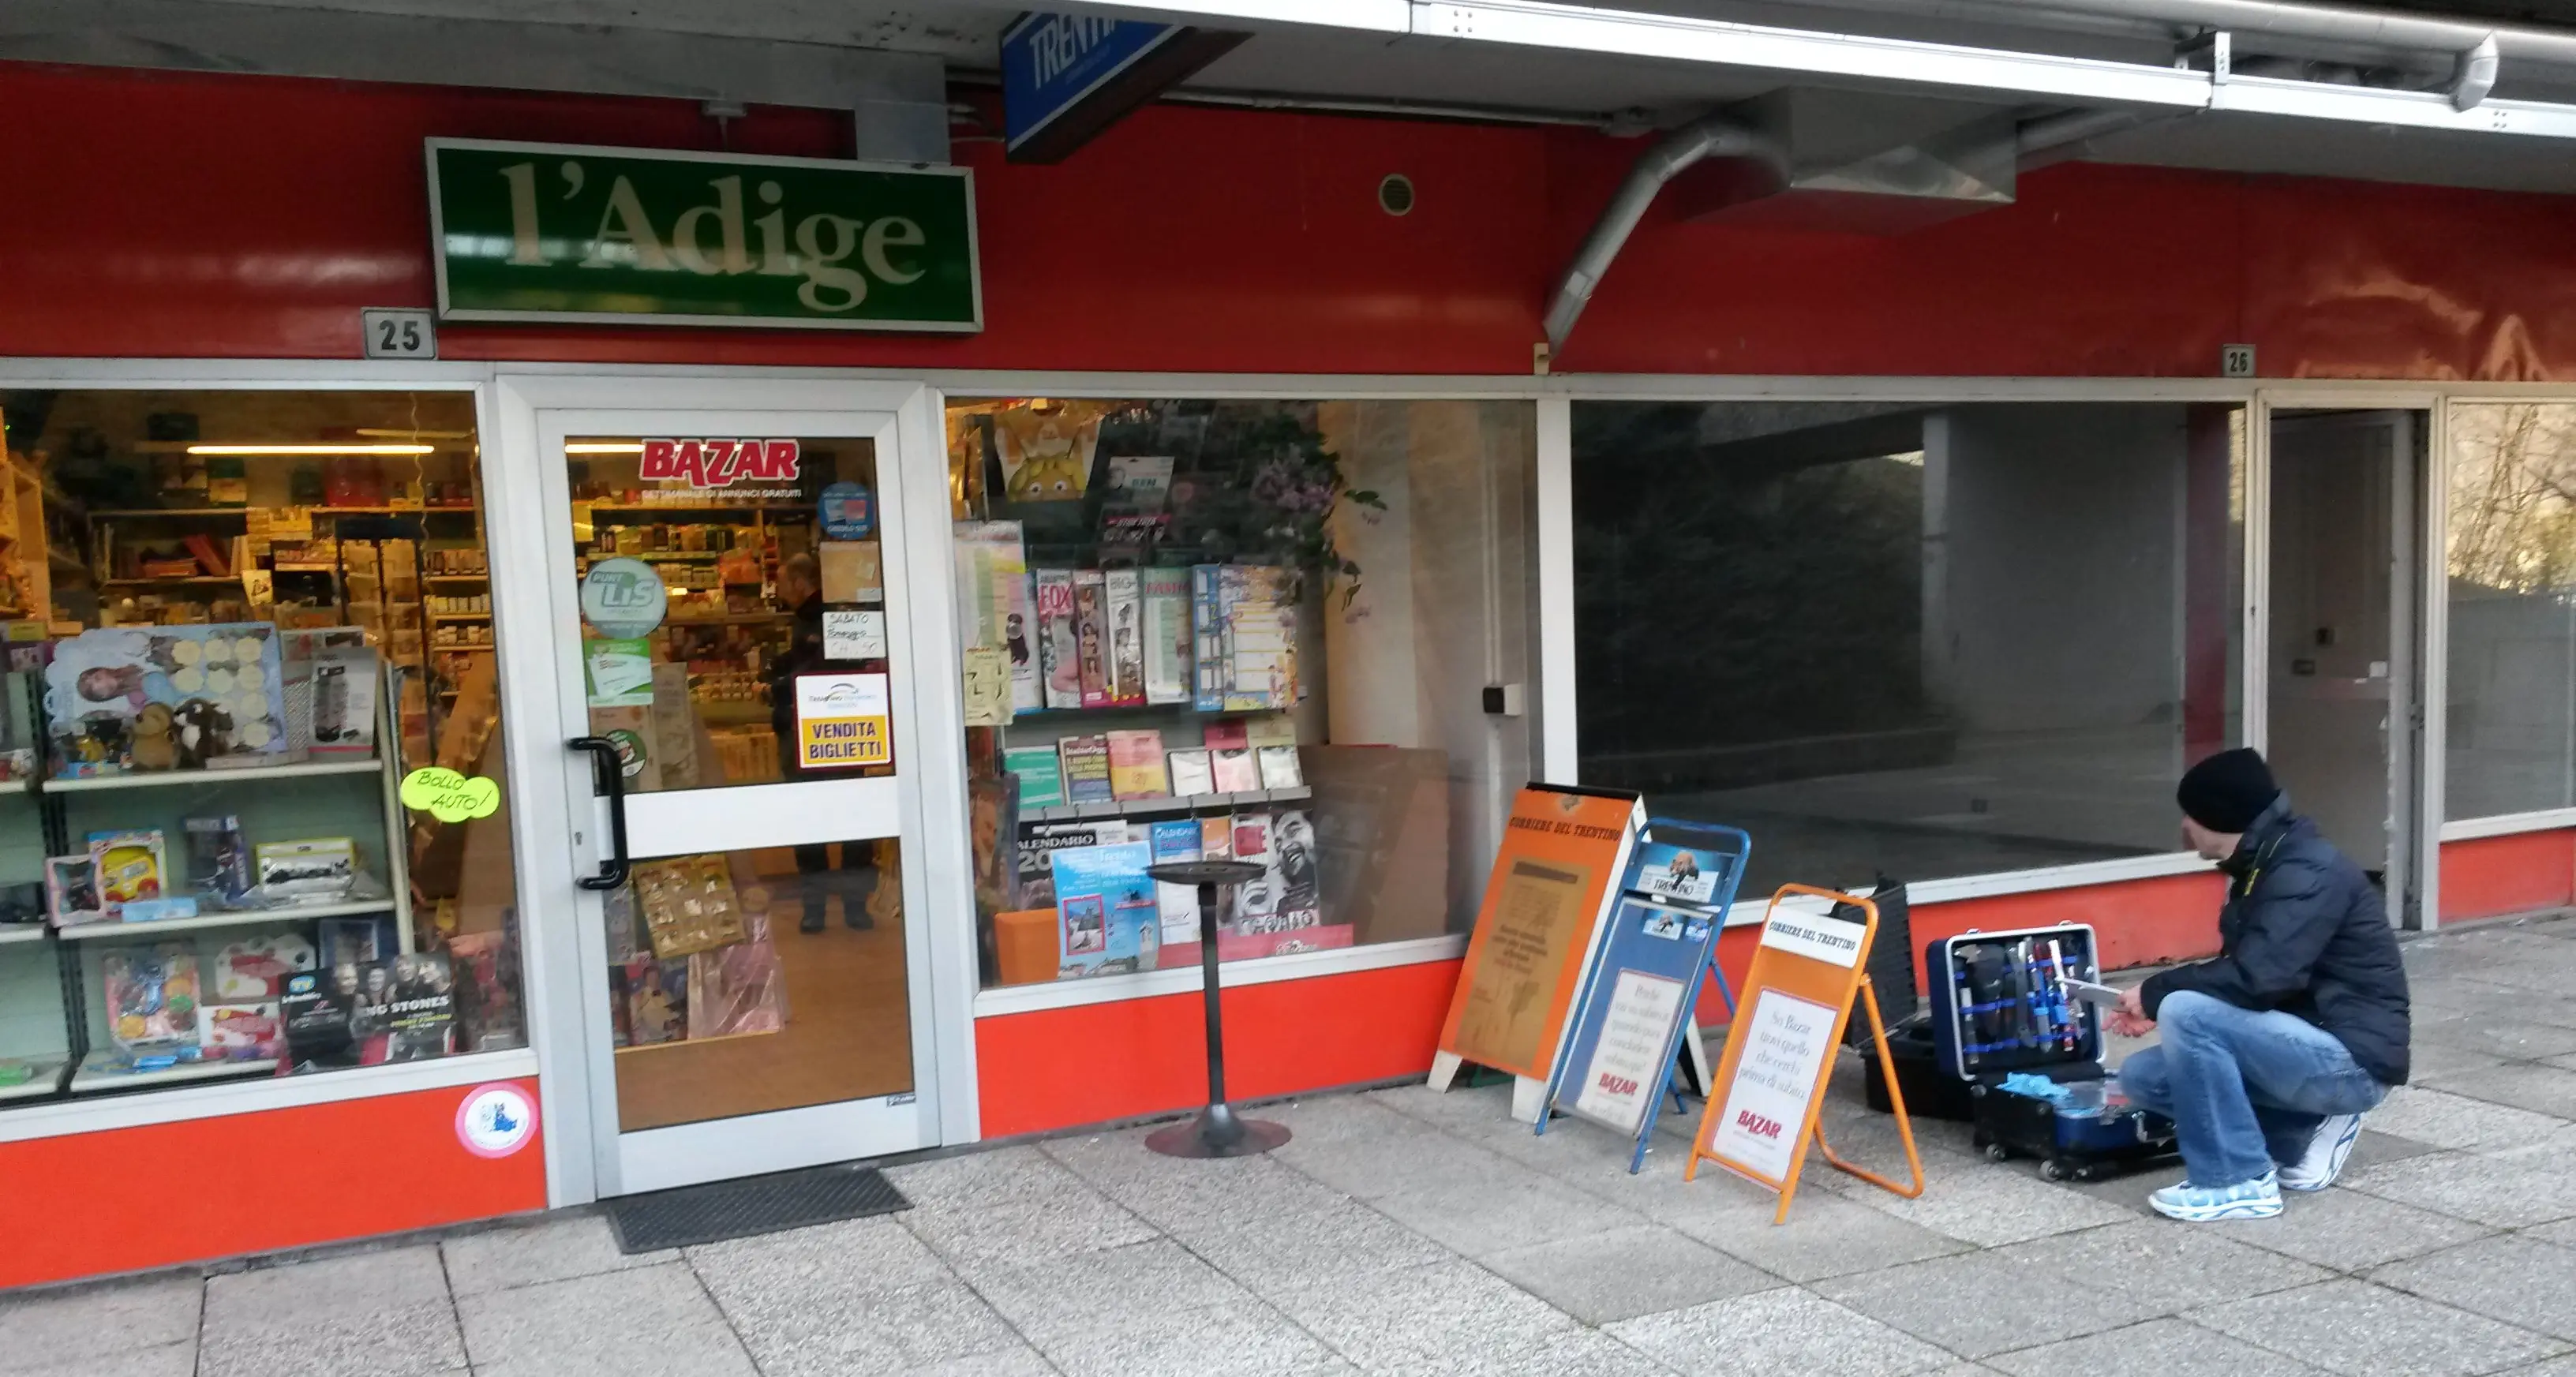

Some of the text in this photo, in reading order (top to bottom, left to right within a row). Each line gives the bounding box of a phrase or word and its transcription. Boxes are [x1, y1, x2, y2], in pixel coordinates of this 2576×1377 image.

[498, 162, 927, 312] l'Adige
[380, 320, 420, 351] 25
[2229, 351, 2248, 373] 26
[640, 439, 800, 488] BAZAR
[812, 721, 876, 739] VENDITA
[810, 741, 882, 760] BIGLIETTI
[1509, 816, 1622, 842] CORRIERE DEL TRENTINO
[1017, 834, 1095, 850] ALENDARIO
[1653, 878, 1694, 896] TRENINO
[1769, 920, 1857, 951] CORRIERE DEL TRENTINO
[1598, 1072, 1639, 1096] BAZAR
[1736, 1109, 1783, 1139] BAZAR
